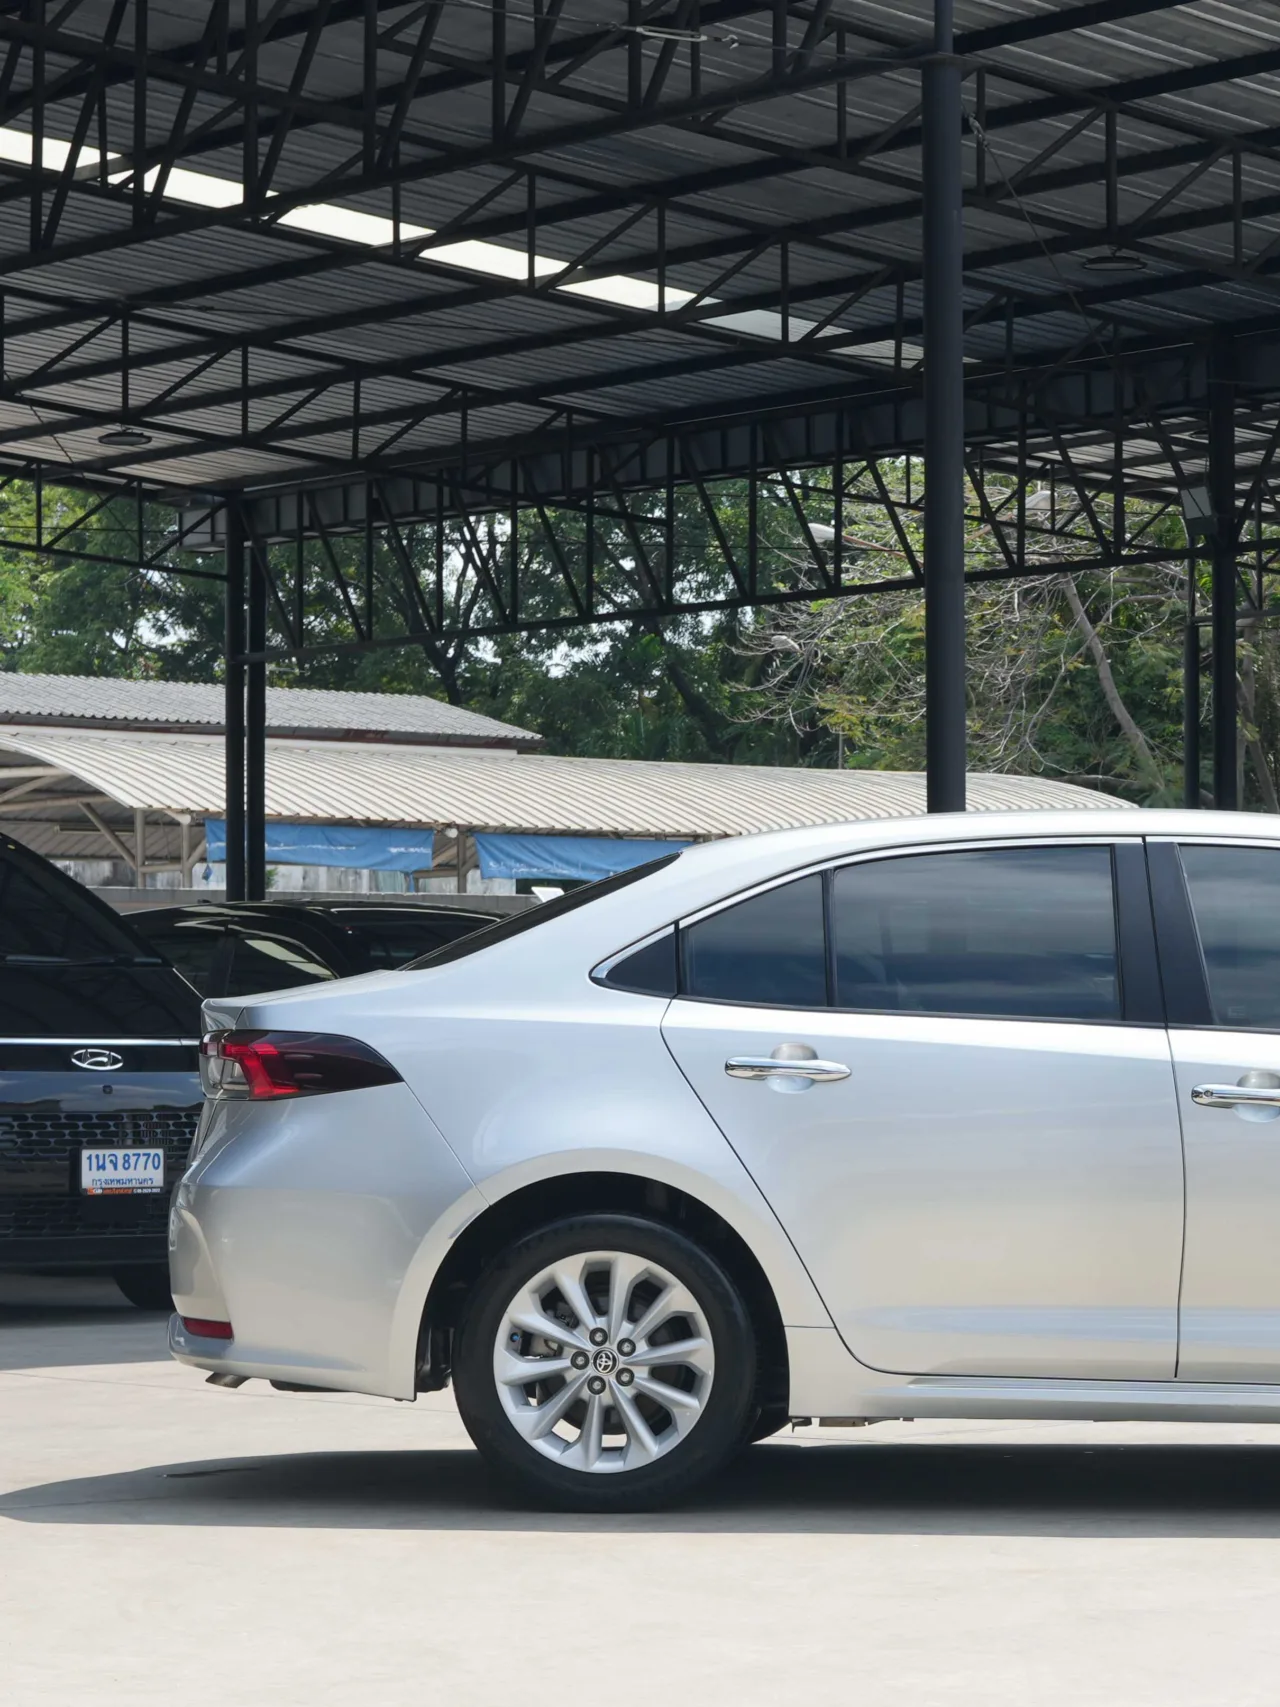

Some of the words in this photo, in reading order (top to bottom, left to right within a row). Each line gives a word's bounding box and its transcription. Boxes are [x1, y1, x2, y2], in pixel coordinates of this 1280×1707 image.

[86, 1153, 118, 1171] 1นจ
[122, 1153, 161, 1171] 8770
[91, 1177, 154, 1188] กรุงเทพมหานคร
